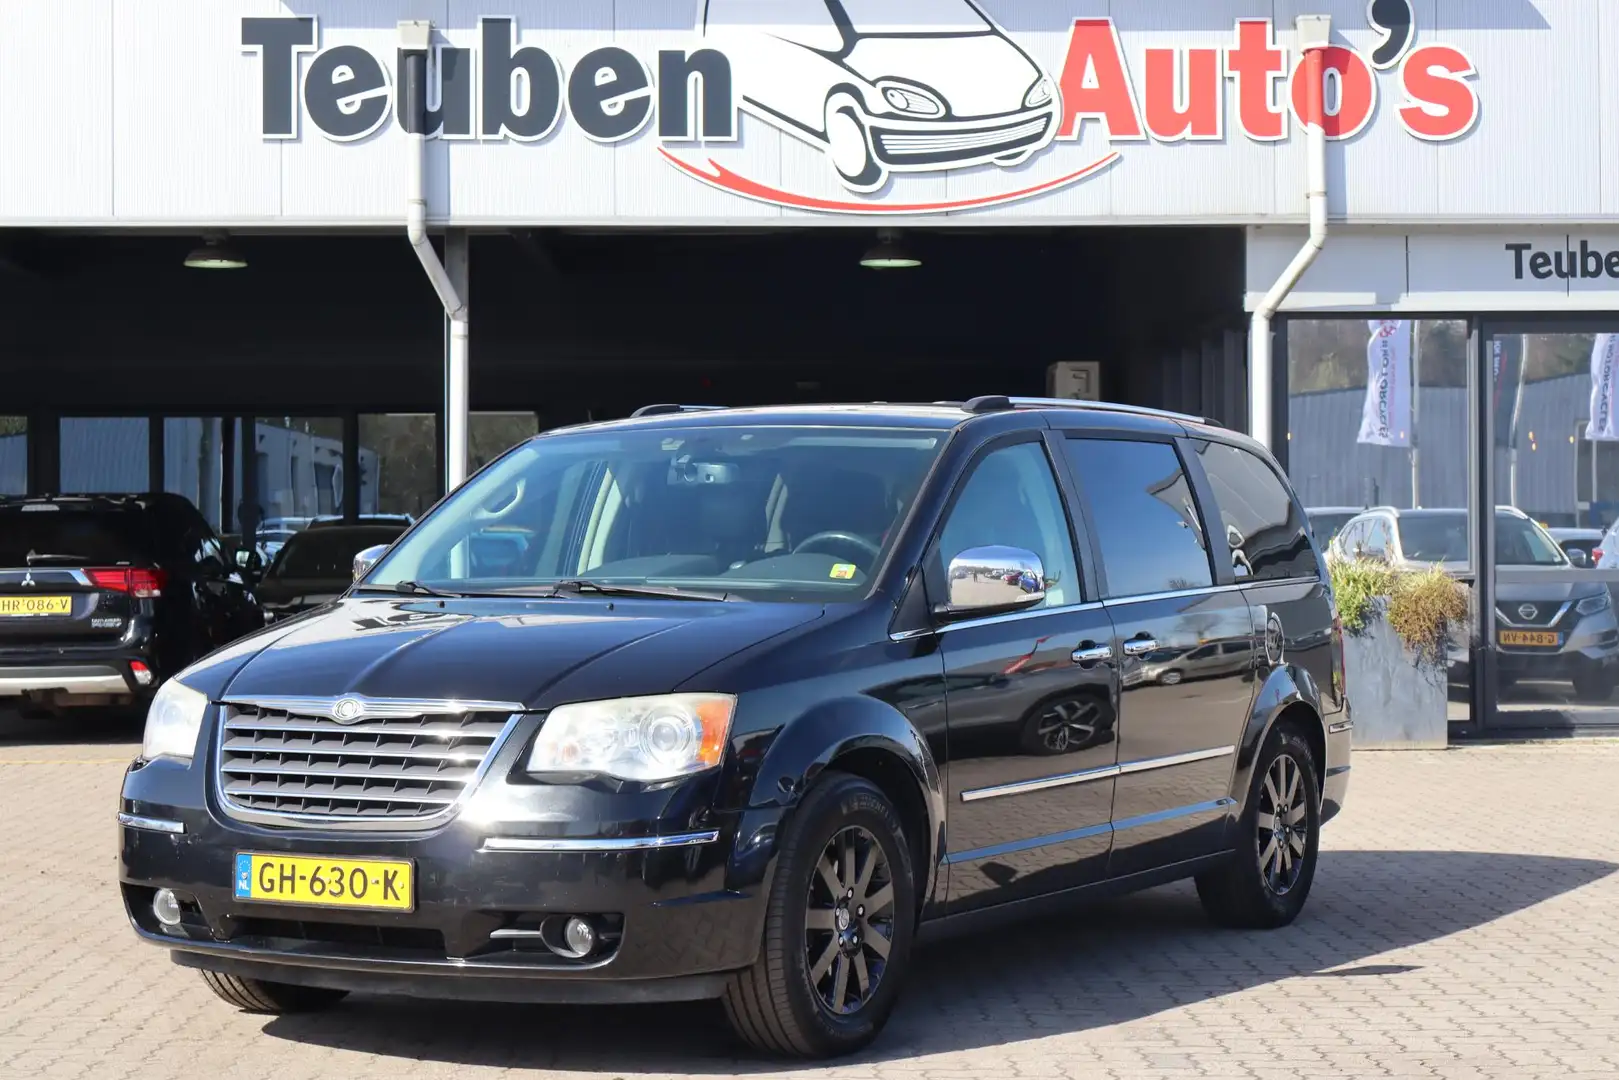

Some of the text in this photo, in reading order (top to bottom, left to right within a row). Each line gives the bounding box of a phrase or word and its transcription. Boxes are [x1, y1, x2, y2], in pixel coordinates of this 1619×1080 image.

[241, 0, 1479, 141] Teuben Auto's
[1505, 240, 1619, 279] Teube
[238, 879, 250, 891] NL
[258, 861, 401, 901] GH-630-K
